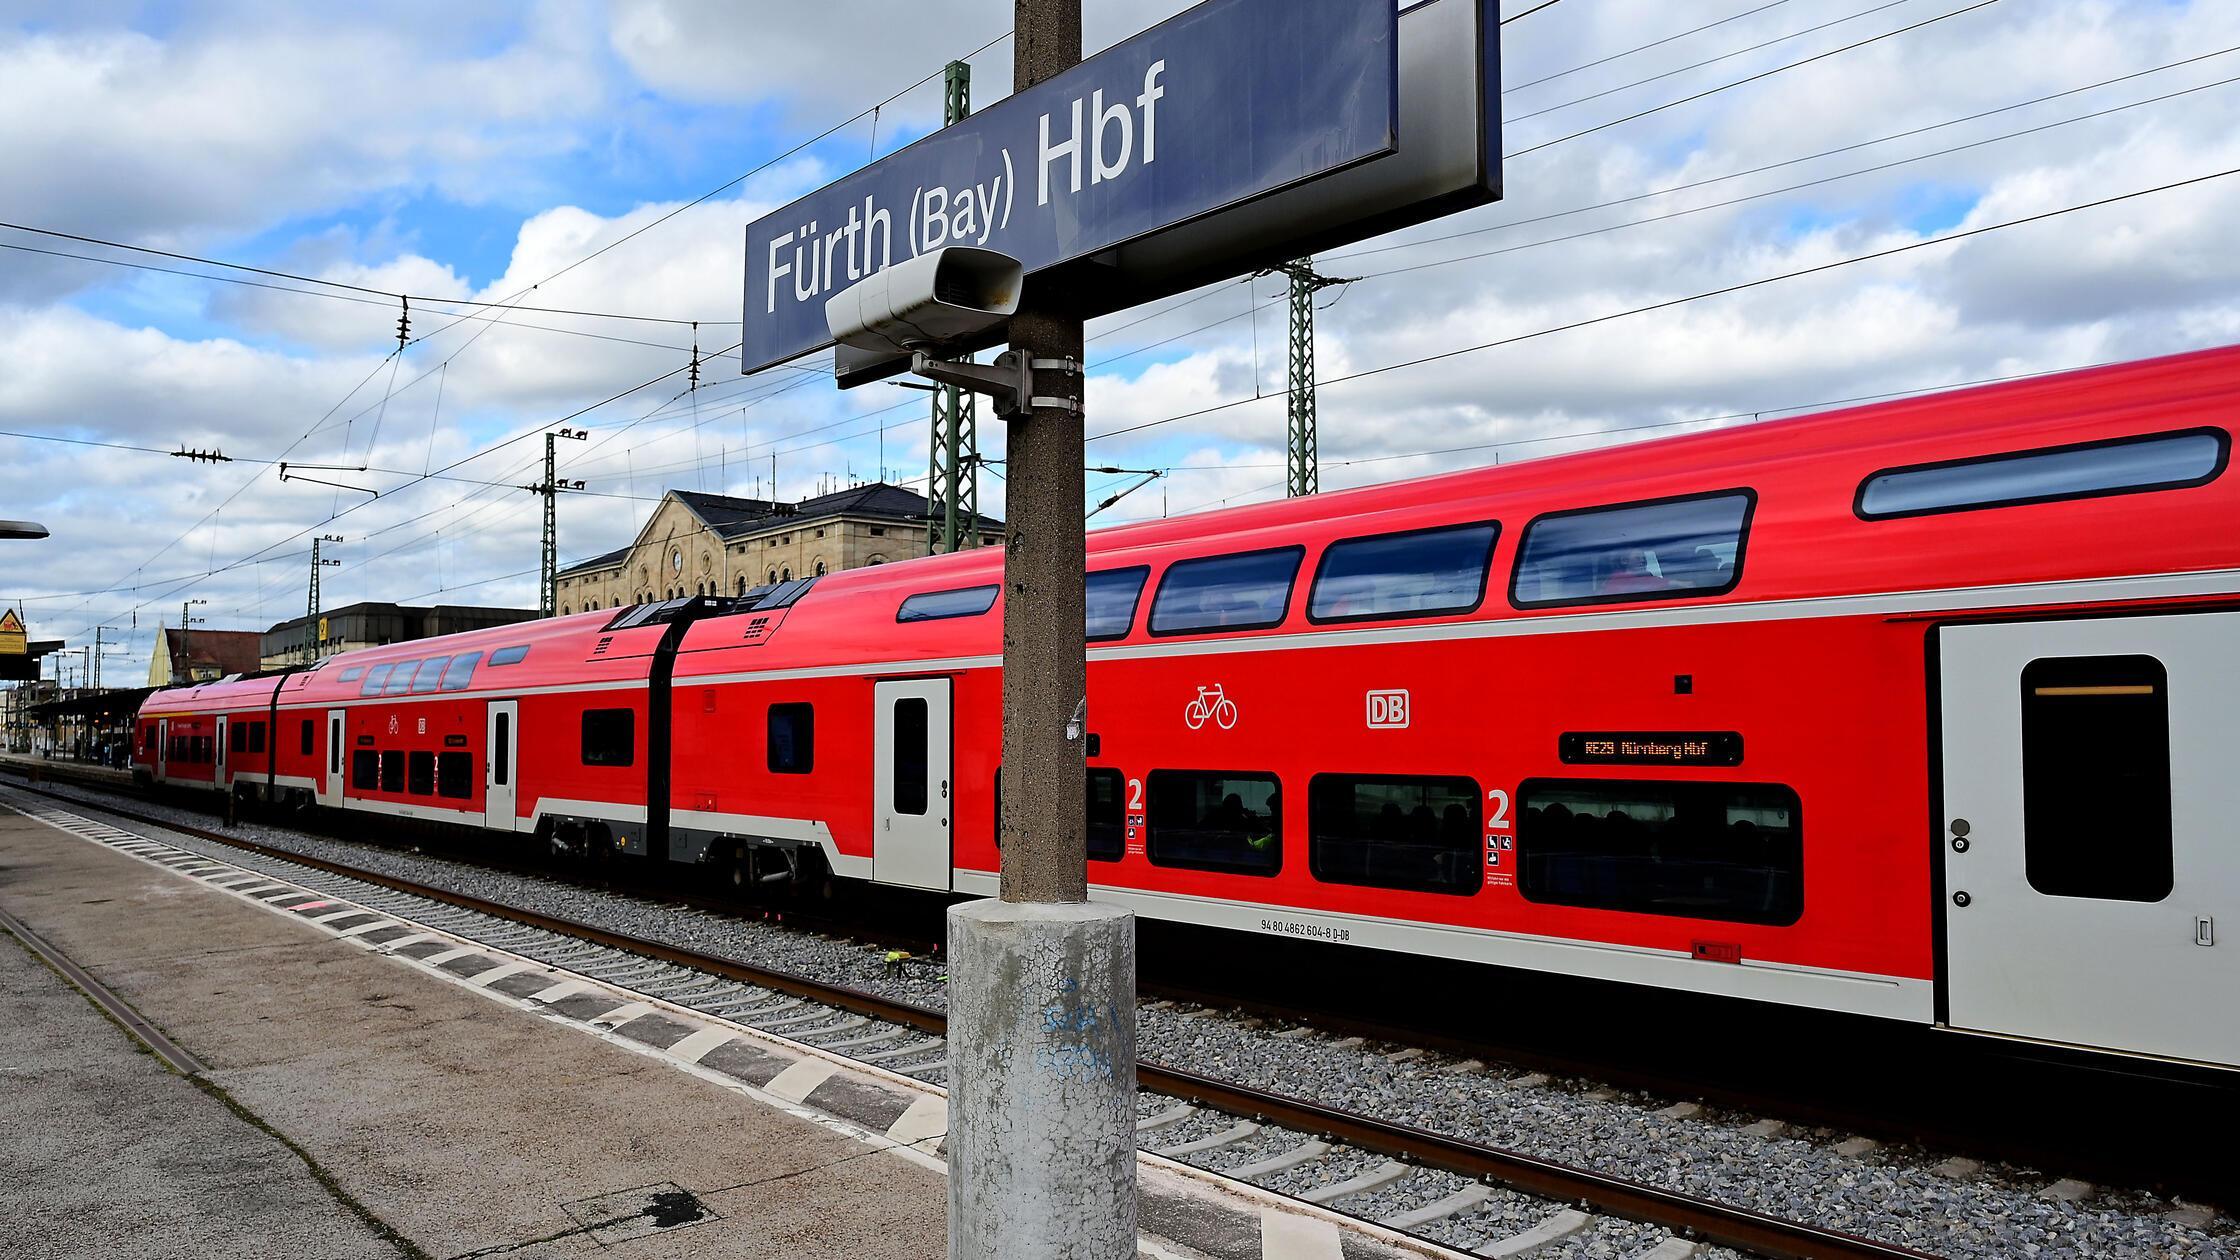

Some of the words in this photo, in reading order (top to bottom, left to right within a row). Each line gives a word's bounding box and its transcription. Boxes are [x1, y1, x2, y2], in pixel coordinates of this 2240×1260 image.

[767, 194, 891, 314] Fürth
[909, 147, 1014, 258] (Bay)
[1038, 59, 1165, 206] Hbf
[1371, 695, 1404, 723] DB
[1585, 741, 1614, 755] RE29
[1621, 741, 1682, 759] Nürnberg
[1684, 741, 1708, 755] Hbf
[1128, 778, 1143, 810] 2
[1488, 789, 1510, 829] 2
[1261, 919, 1271, 931] 94
[1273, 920, 1283, 932] 80
[1285, 922, 1305, 935] 4862
[1307, 925, 1331, 938] 604-8
